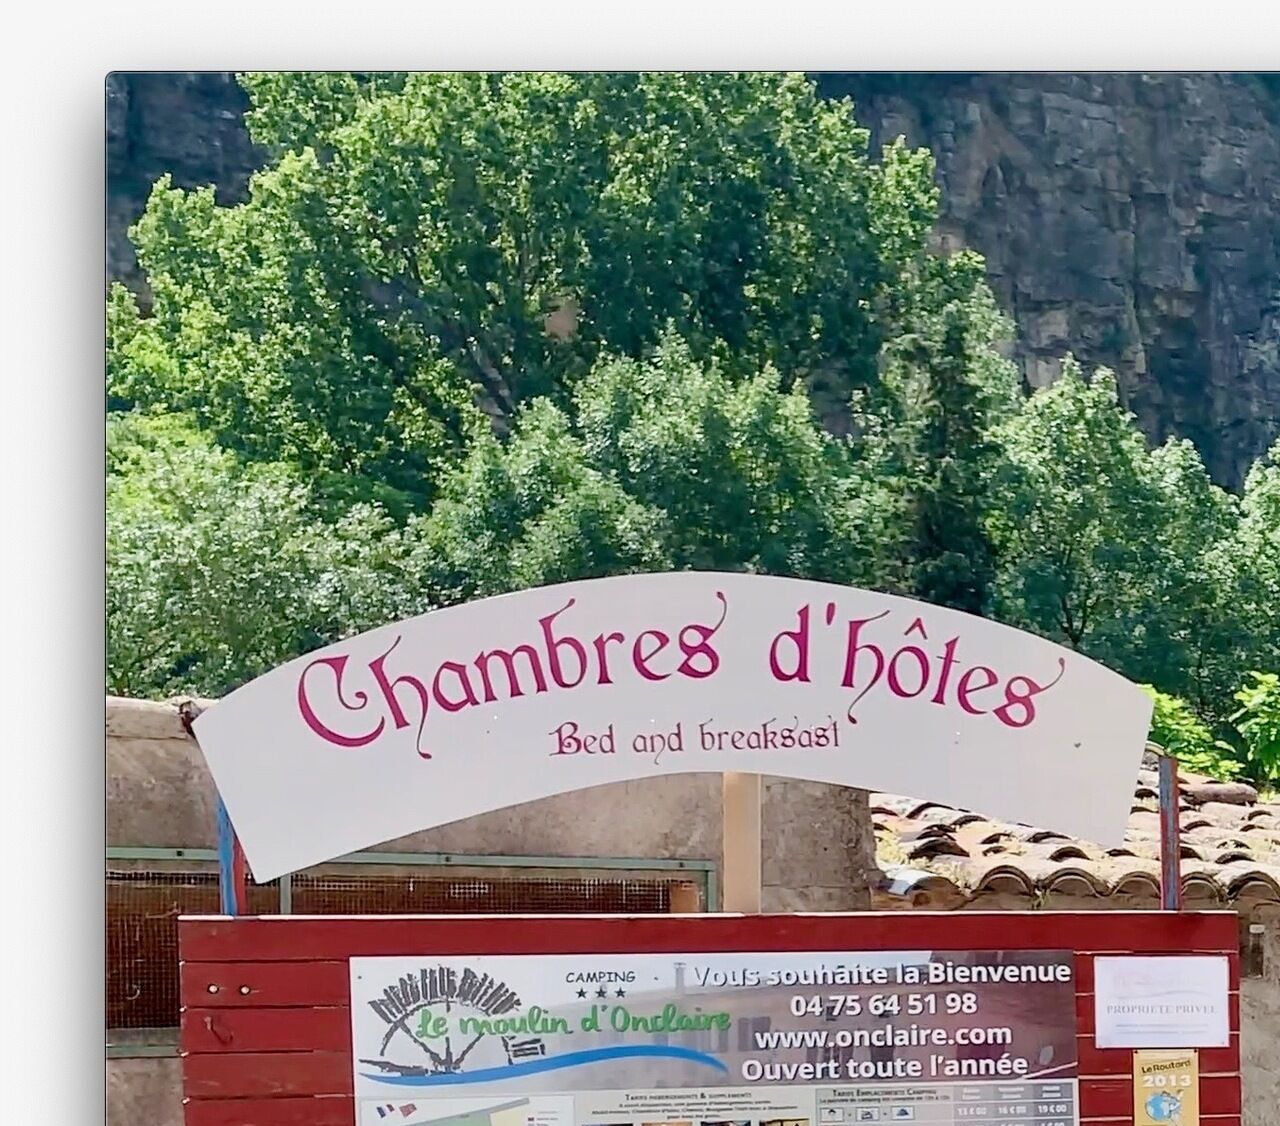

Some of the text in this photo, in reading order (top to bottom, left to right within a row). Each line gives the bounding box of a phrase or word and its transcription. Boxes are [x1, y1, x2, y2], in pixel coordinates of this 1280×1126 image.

[297, 591, 1066, 760] Chambres d'hôtes
[549, 721, 615, 756] Bed
[632, 722, 684, 765] and
[566, 971, 636, 983] CAMPING
[695, 965, 760, 987] Vous
[897, 963, 920, 984] la
[929, 962, 1071, 984] Bienvenue
[790, 992, 978, 1017] 04 75 64 51 98
[416, 1003, 732, 1039] Le moulin d'Onclaire
[755, 1024, 1012, 1049] www.onclaire.com
[741, 1054, 1029, 1081] Ouvert toute l'année
[1141, 1059, 1191, 1074] Le Routard
[1143, 1074, 1192, 1087] 2013
